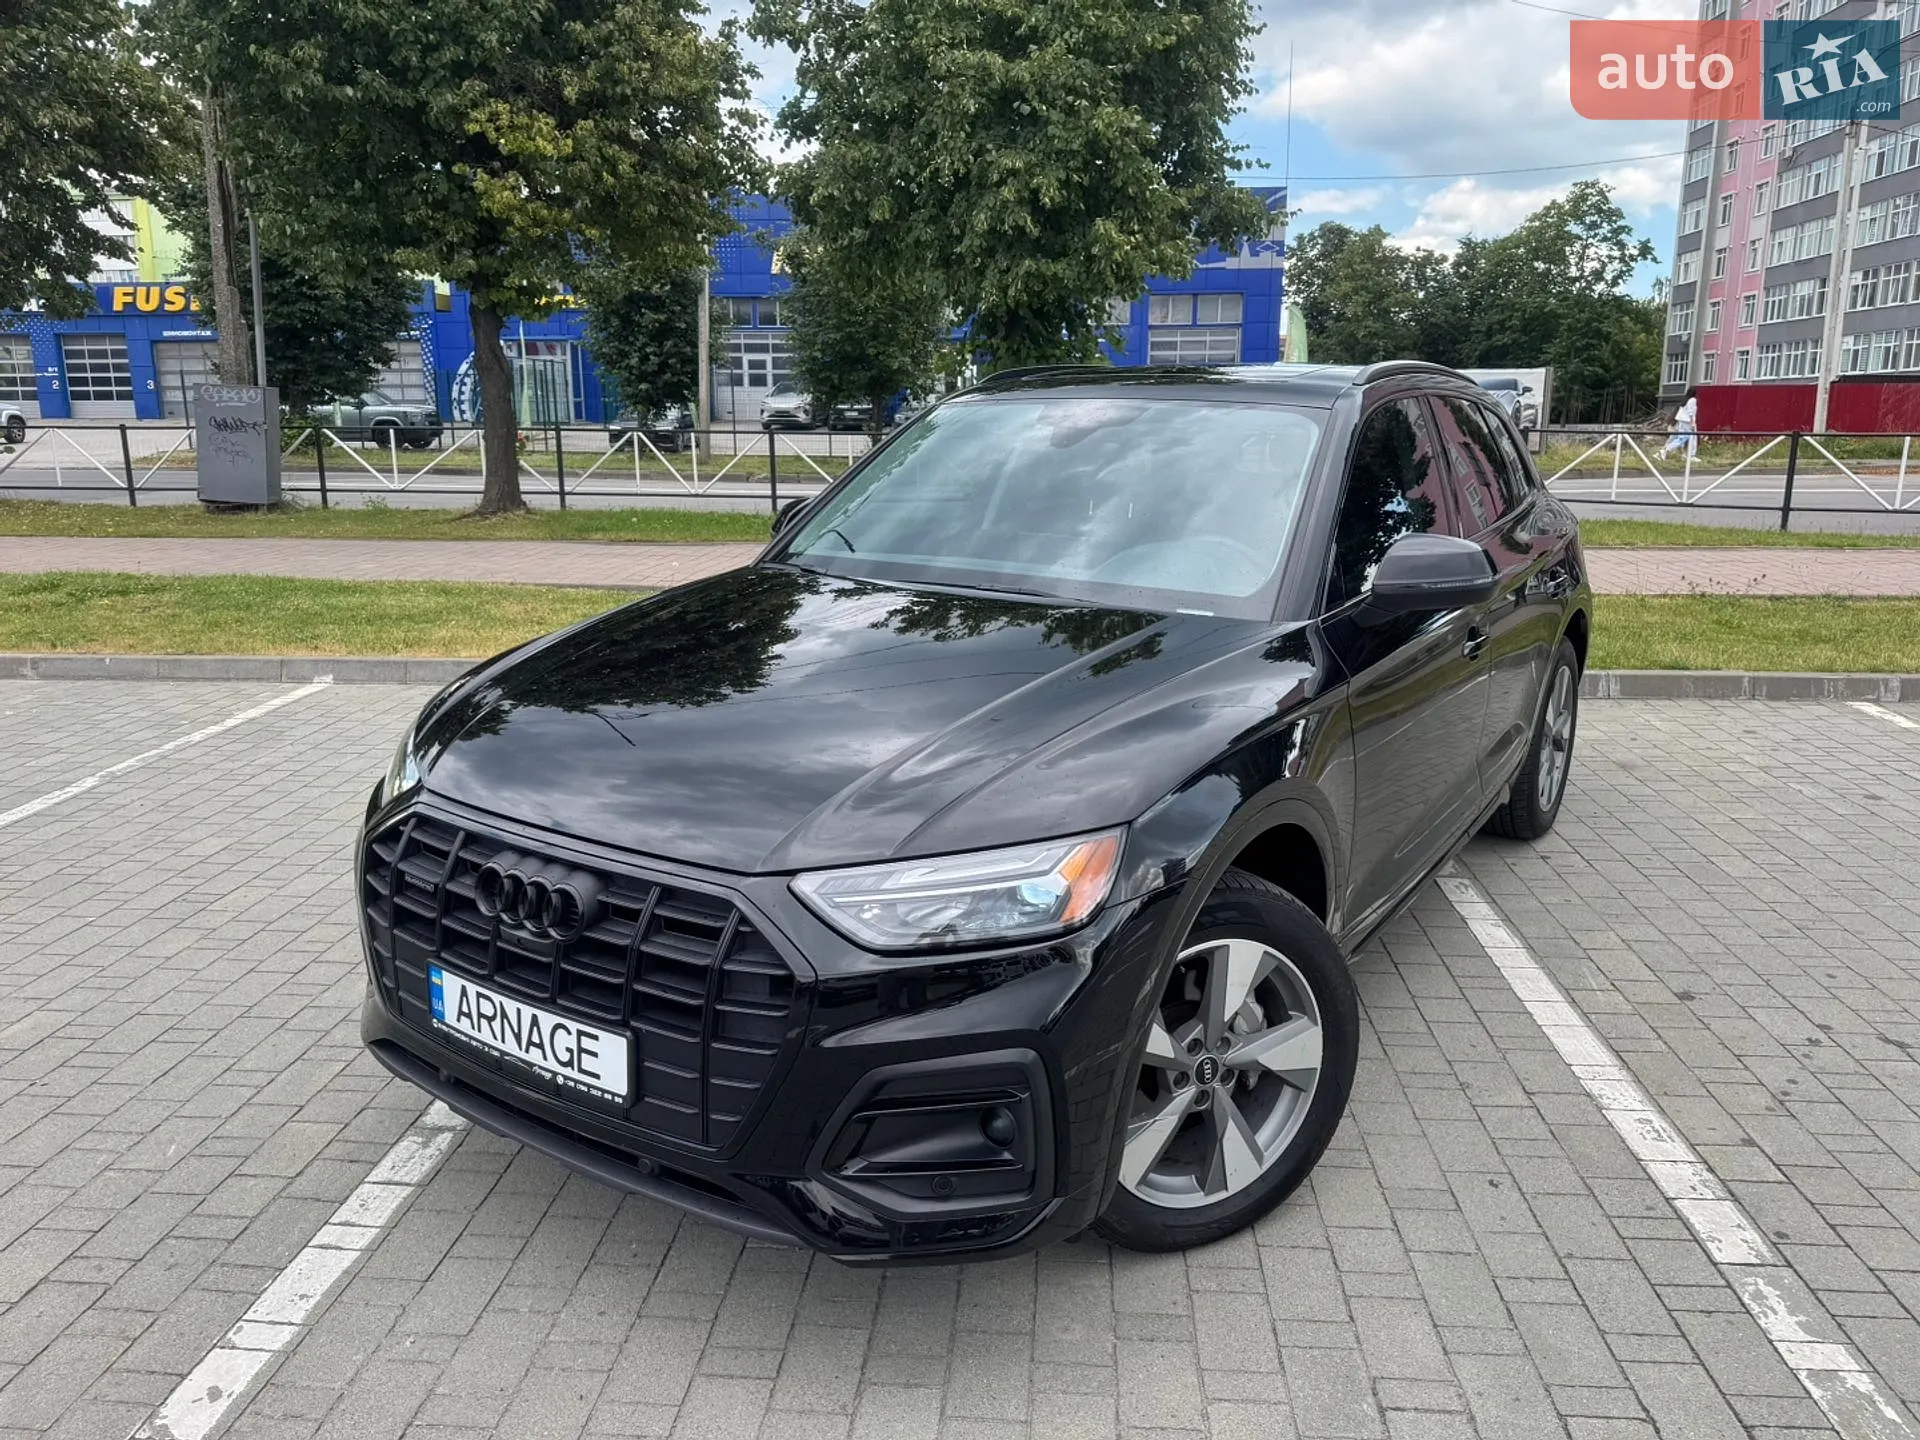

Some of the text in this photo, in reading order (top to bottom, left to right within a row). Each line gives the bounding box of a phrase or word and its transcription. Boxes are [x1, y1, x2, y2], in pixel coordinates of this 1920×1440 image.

[51, 379, 60, 390] 2
[146, 379, 155, 390] 3
[456, 984, 602, 1081] ARNAGE
